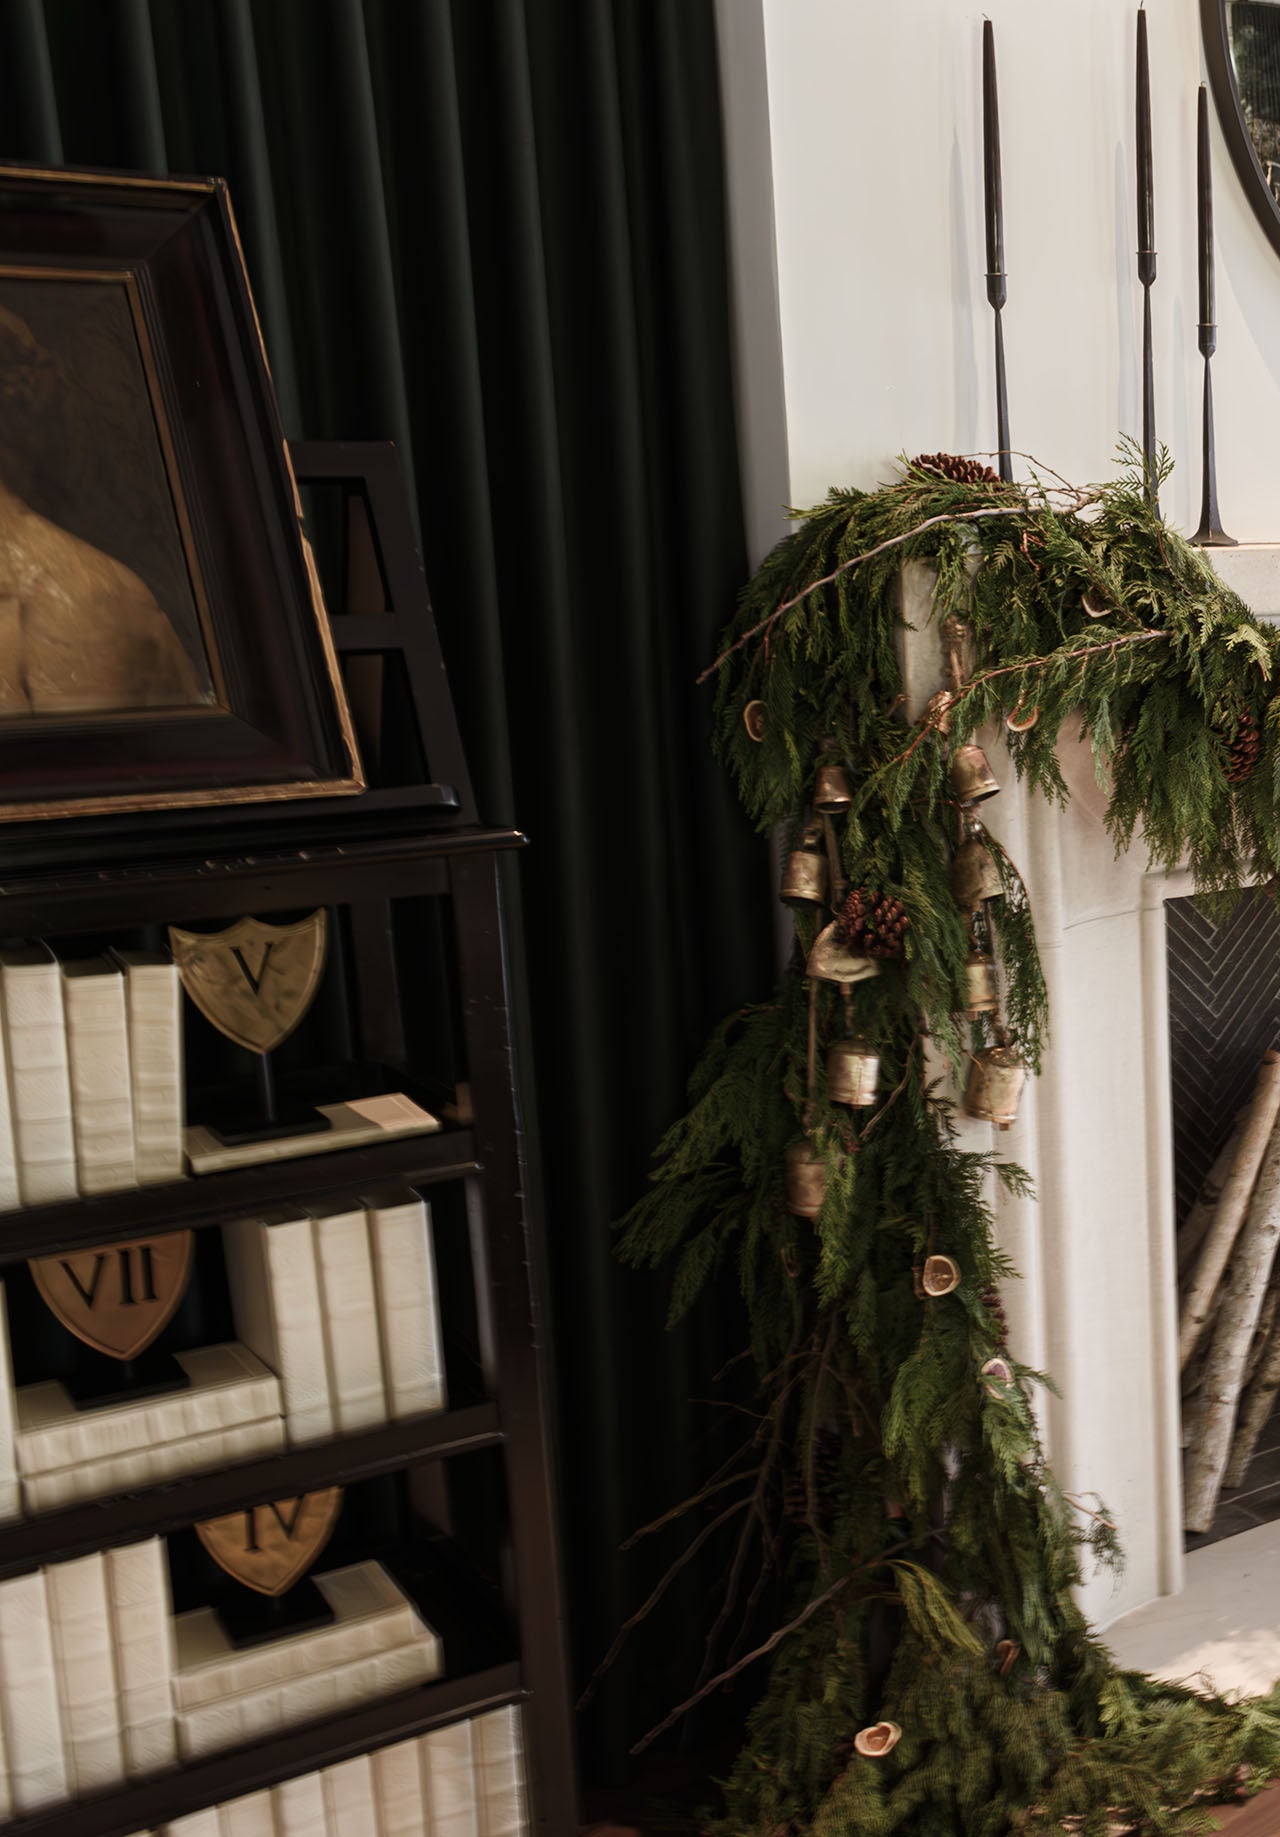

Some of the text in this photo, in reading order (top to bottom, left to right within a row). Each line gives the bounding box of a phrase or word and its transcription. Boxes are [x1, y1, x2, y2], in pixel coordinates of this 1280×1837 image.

[229, 941, 273, 997] V
[58, 1246, 158, 1311] VII
[243, 1496, 306, 1553] IV
